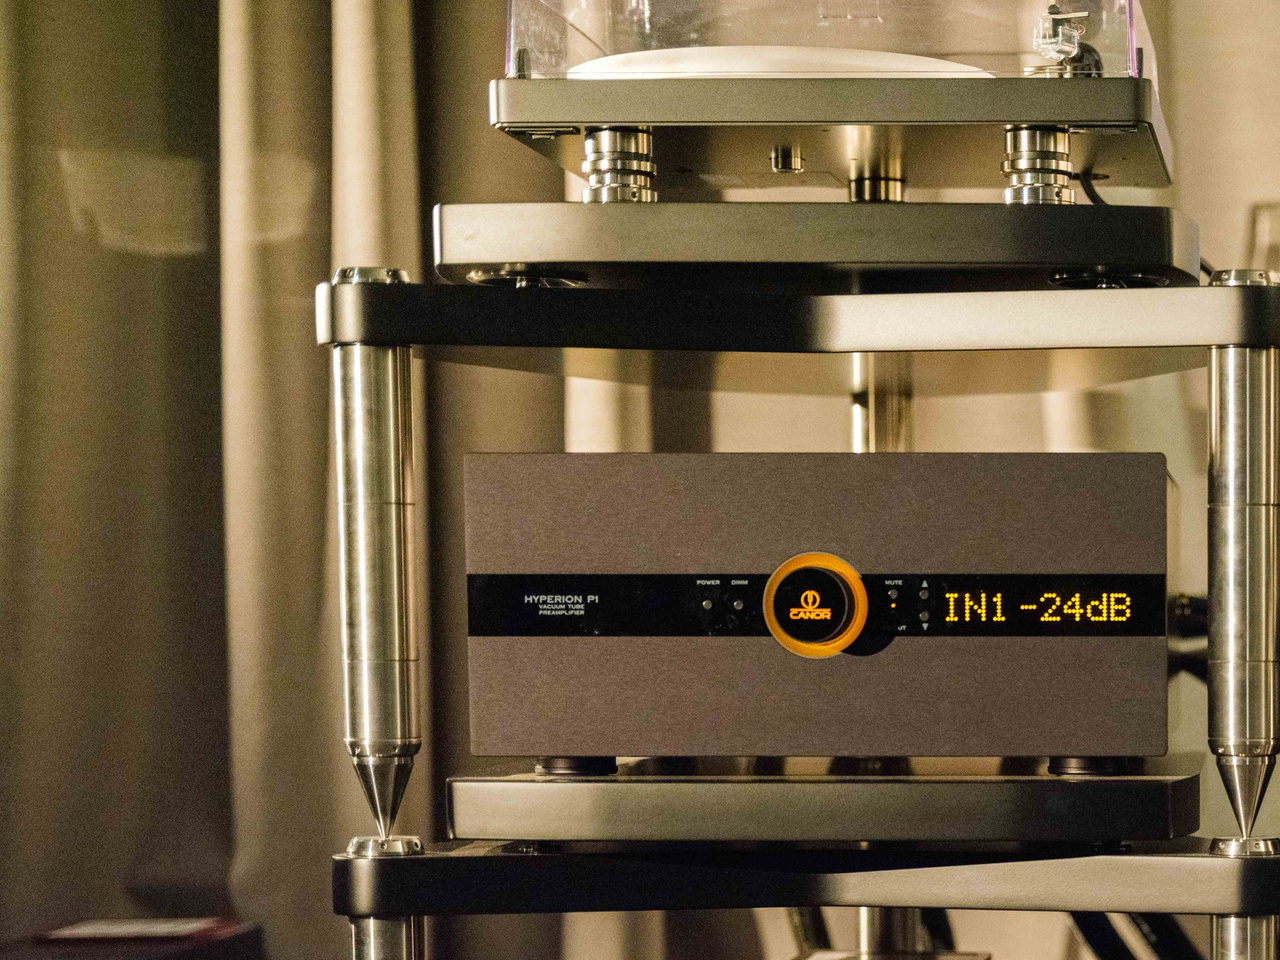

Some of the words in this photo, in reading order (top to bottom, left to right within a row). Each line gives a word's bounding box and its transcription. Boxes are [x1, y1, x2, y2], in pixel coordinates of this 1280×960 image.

[524, 595, 583, 604] HYPERION
[587, 595, 599, 604] P1
[945, 592, 1006, 622] IN1
[1019, 592, 1131, 622] -24dB
[790, 611, 832, 620] CANOR
